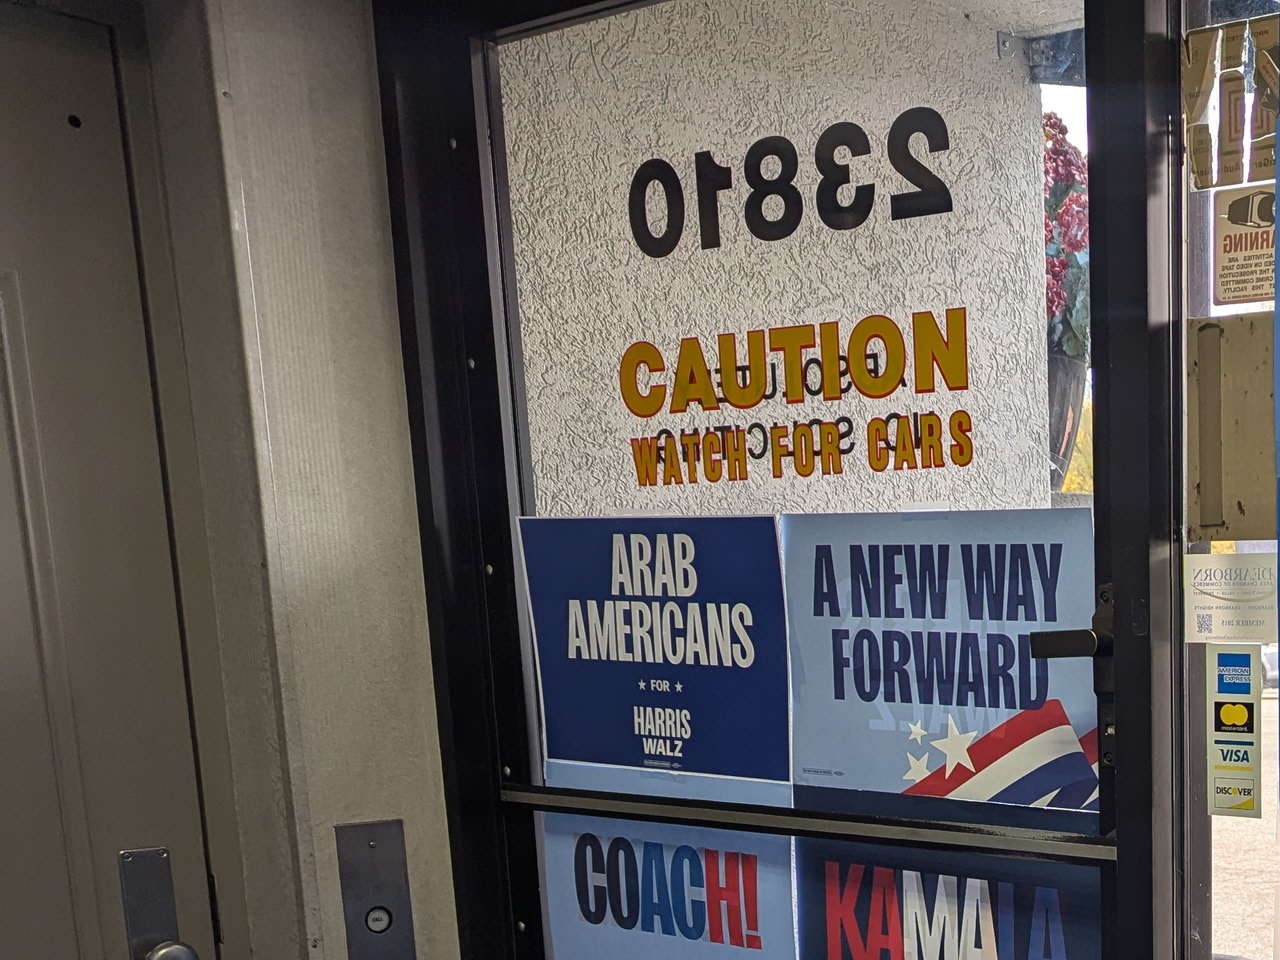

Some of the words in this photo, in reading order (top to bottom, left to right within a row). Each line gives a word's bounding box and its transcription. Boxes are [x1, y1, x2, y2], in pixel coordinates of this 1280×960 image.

[619, 306, 969, 418] CAUTION
[630, 428, 747, 488] WATCH
[771, 420, 844, 479] FOR
[868, 409, 973, 473] CARS
[610, 533, 697, 598] ARAB
[813, 544, 841, 618] A
[849, 543, 950, 620] NEW
[960, 542, 1063, 623] WAY
[567, 598, 755, 669] AMERICANS
[650, 679, 670, 692] FOR
[831, 627, 1050, 711] FORWARD
[633, 706, 691, 739] HARRIS
[642, 737, 683, 757] WALZ
[1218, 749, 1250, 763] VISA
[1216, 786, 1252, 797] DISCOVER
[573, 832, 763, 951] COACH!
